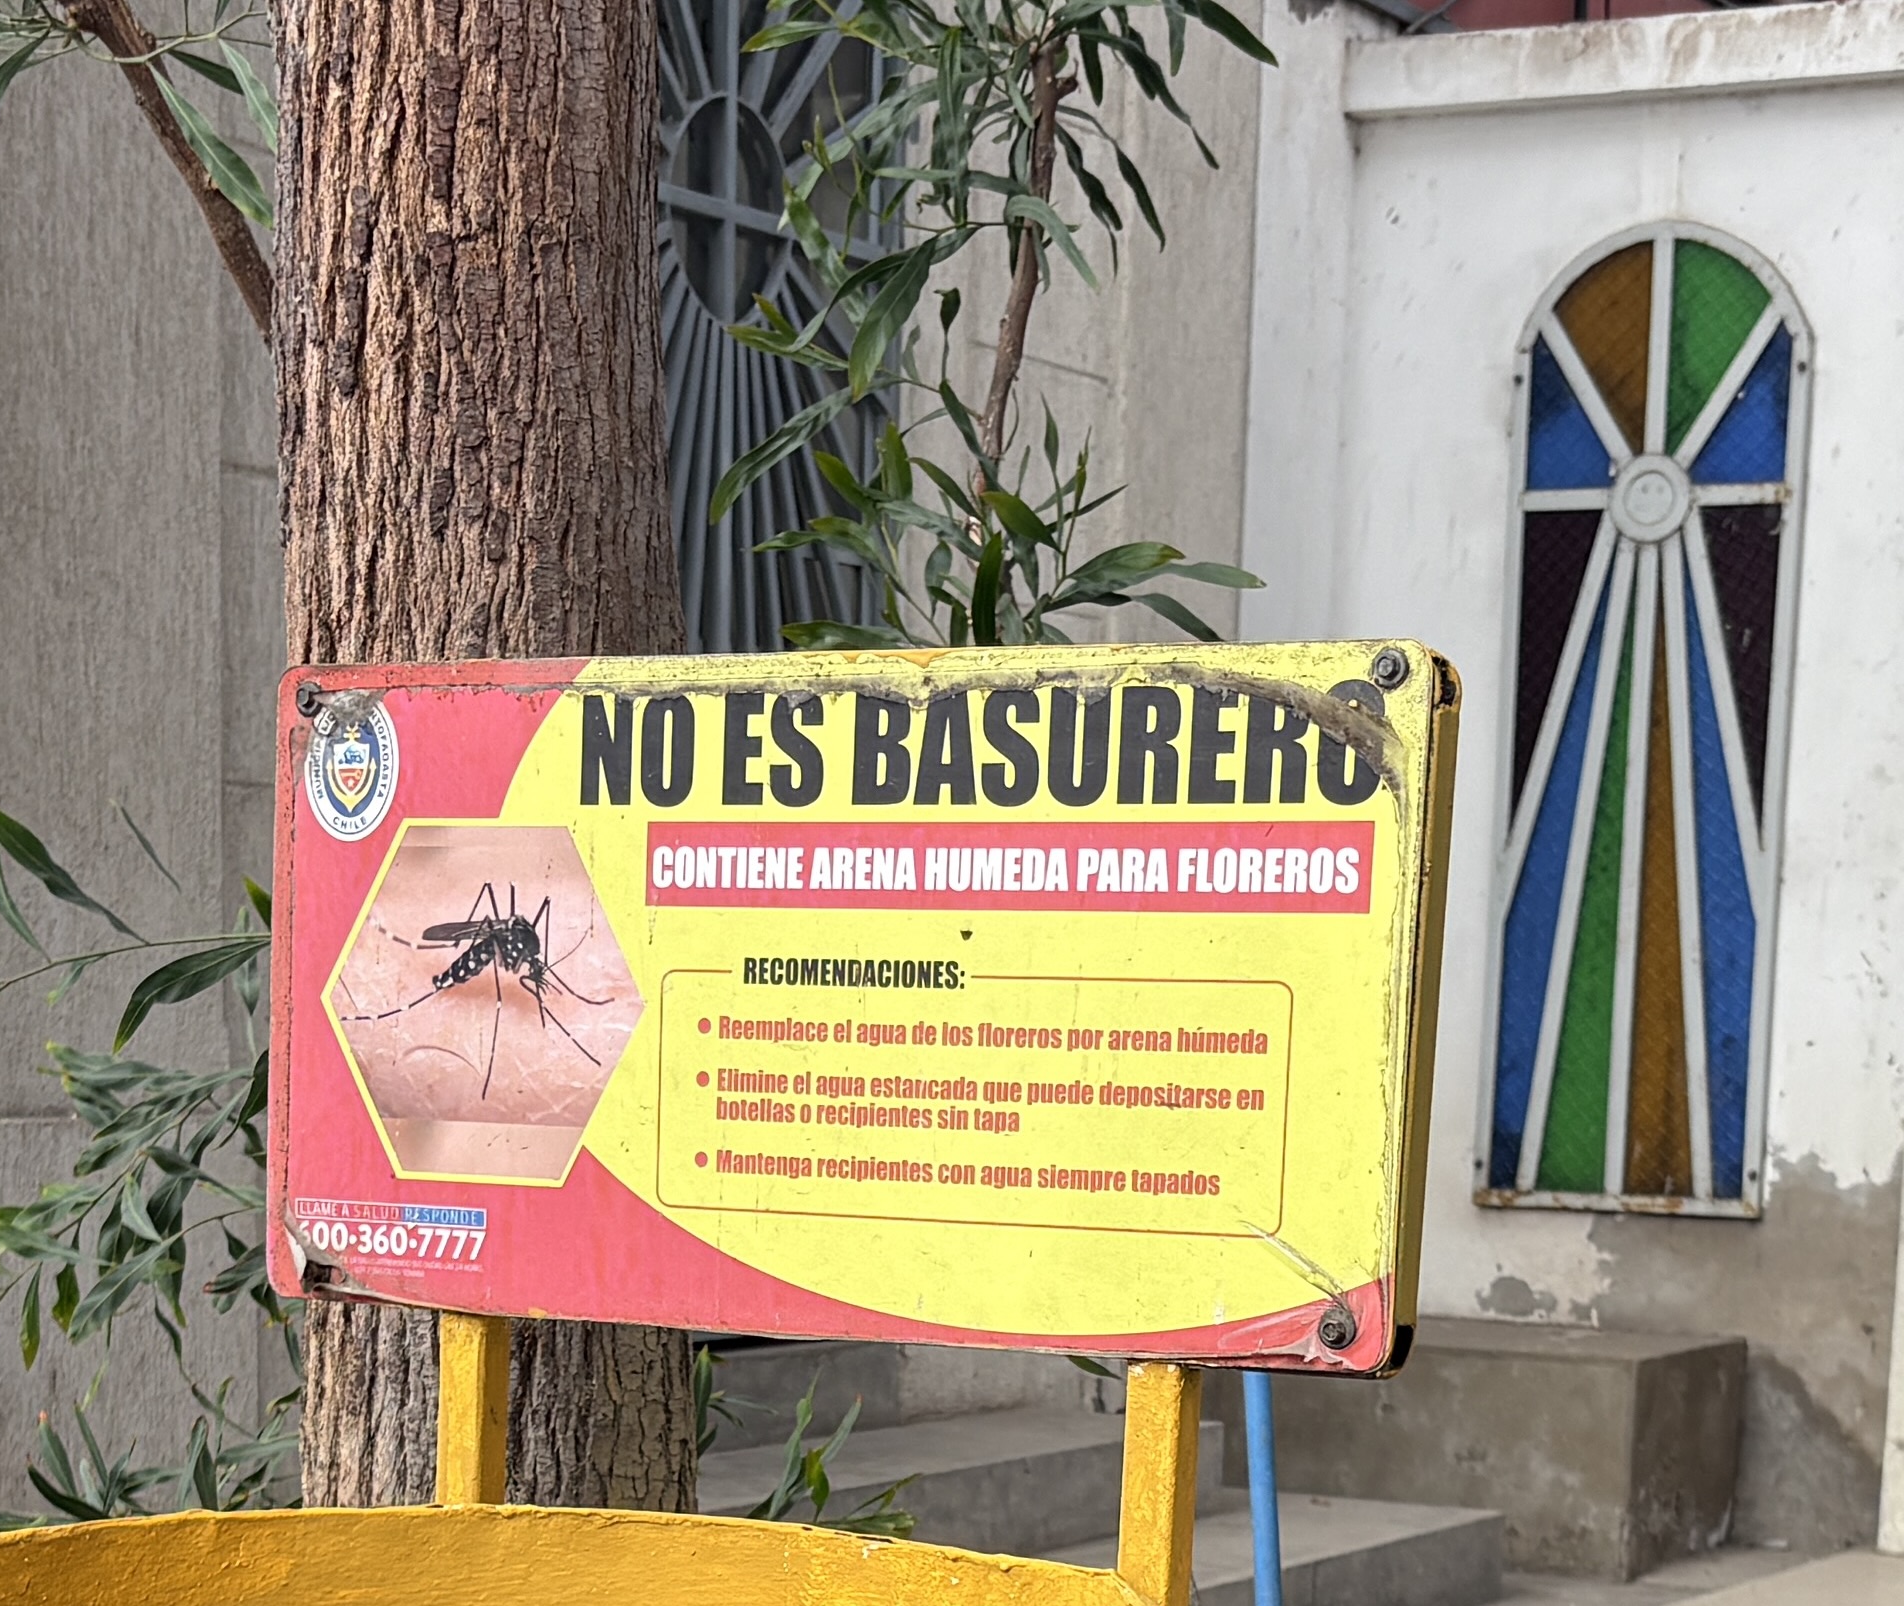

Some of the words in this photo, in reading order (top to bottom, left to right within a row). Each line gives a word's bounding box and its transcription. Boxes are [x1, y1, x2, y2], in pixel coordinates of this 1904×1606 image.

[580, 692, 695, 807] NO
[722, 691, 824, 807] ES
[851, 680, 1386, 807] BASURERO
[332, 815, 367, 830] CHILE
[652, 846, 804, 889] CONTIENE
[809, 847, 916, 891] ARENA
[924, 847, 1069, 892] HUMEDA
[1076, 847, 1169, 893] PARA
[1177, 847, 1360, 895] FLOREROS
[743, 957, 965, 989] RECOMENDACIONES:
[718, 1015, 828, 1043] Reemplace
[833, 1019, 852, 1043] el
[856, 1023, 906, 1046] agua
[911, 1021, 936, 1045] de
[942, 1022, 973, 1047] los
[978, 1023, 1062, 1048] floreros
[1067, 1028, 1104, 1051] por
[1108, 1030, 1171, 1052] arena
[1177, 1026, 1268, 1054] húmeda
[717, 1068, 788, 1094] Elimine
[793, 1071, 811, 1095] el
[816, 1076, 865, 1098] agua
[870, 1076, 977, 1101] estancada
[983, 1080, 1021, 1104] que
[1027, 1080, 1094, 1105] puede
[1099, 1081, 1231, 1109] depositarse
[1237, 1088, 1264, 1110] en
[716, 1097, 795, 1122] botellas
[800, 1102, 811, 1123] o
[816, 1102, 932, 1129] recipientes
[938, 1106, 968, 1130] sin
[974, 1109, 1020, 1134] tapa
[716, 1150, 812, 1178] Mantenga
[817, 1156, 933, 1183] recipientes
[938, 1162, 975, 1185] con
[981, 1166, 1032, 1188] agua
[1038, 1165, 1126, 1193] siempre
[1132, 1170, 1220, 1195] tapados
[299, 1201, 338, 1217] LLAME
[341, 1203, 350, 1217] A
[353, 1205, 399, 1220] SALUD
[405, 1207, 478, 1225] RESPONDE
